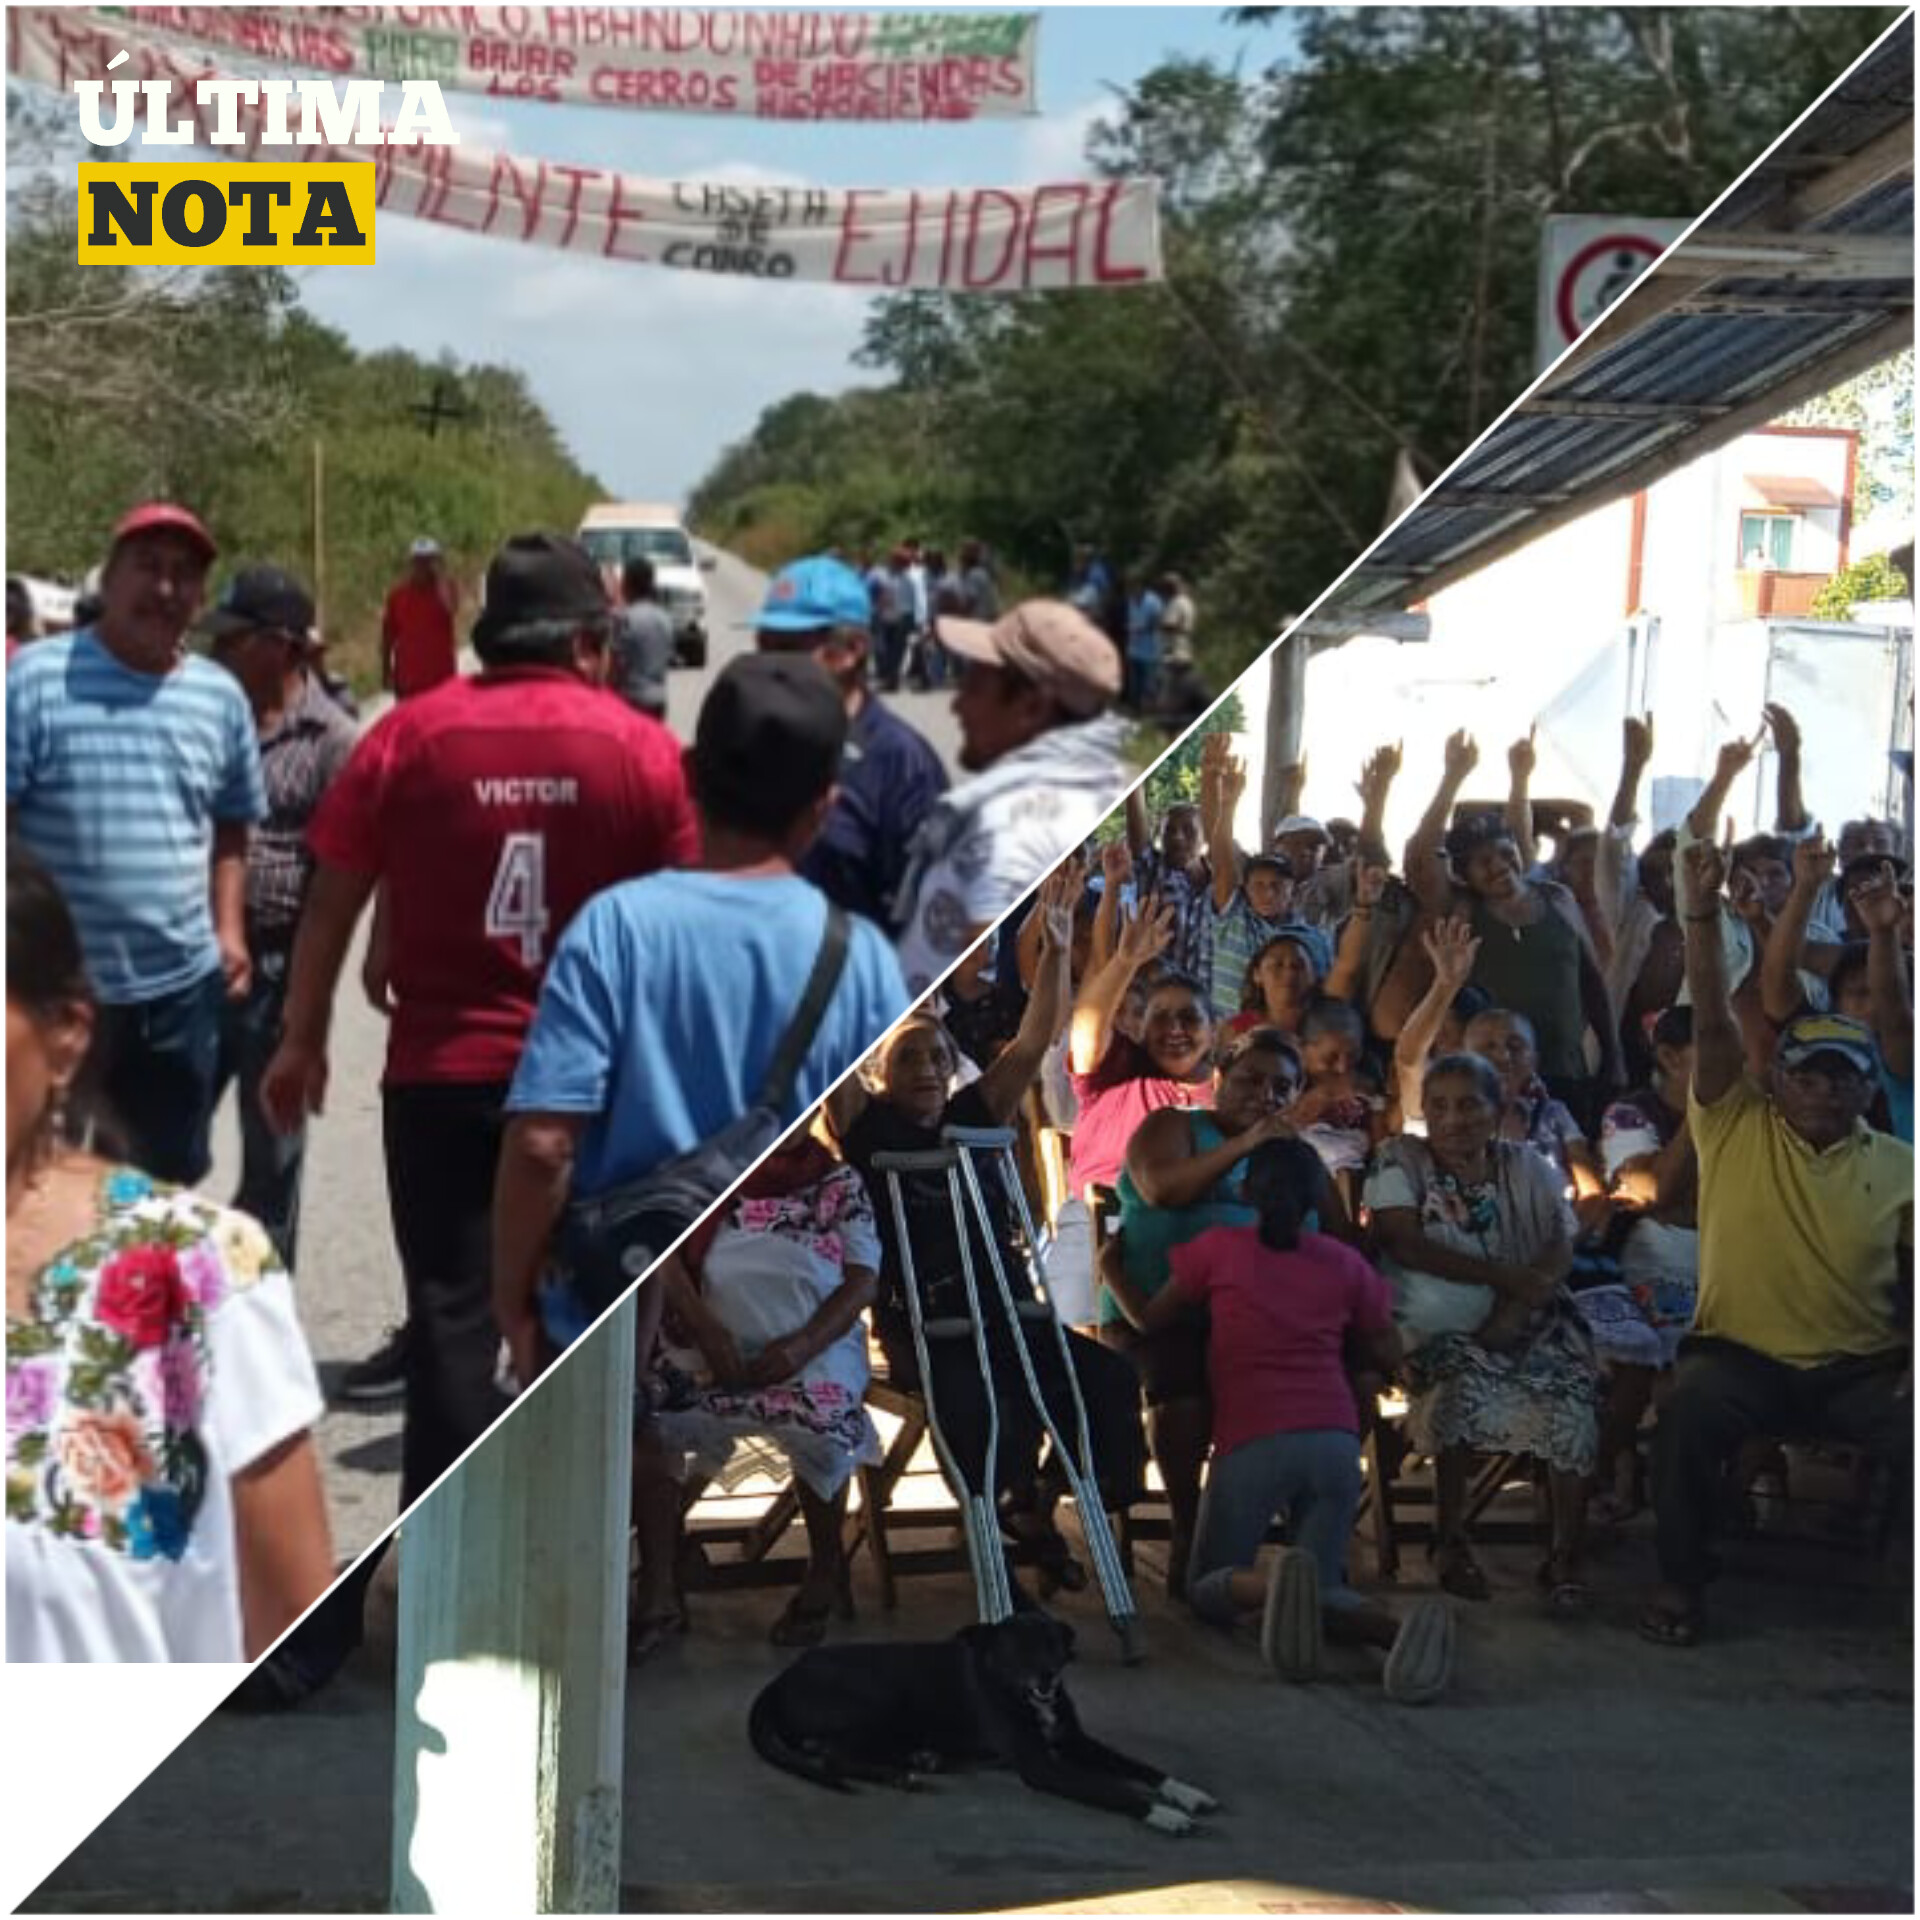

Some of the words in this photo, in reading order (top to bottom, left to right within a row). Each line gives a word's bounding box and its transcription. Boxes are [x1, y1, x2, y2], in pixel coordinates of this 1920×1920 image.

[590, 66, 738, 110] CERROS
[832, 180, 1148, 288] EJIDAL
[472, 776, 580, 807] VICTOR
[485, 831, 550, 970] 4
